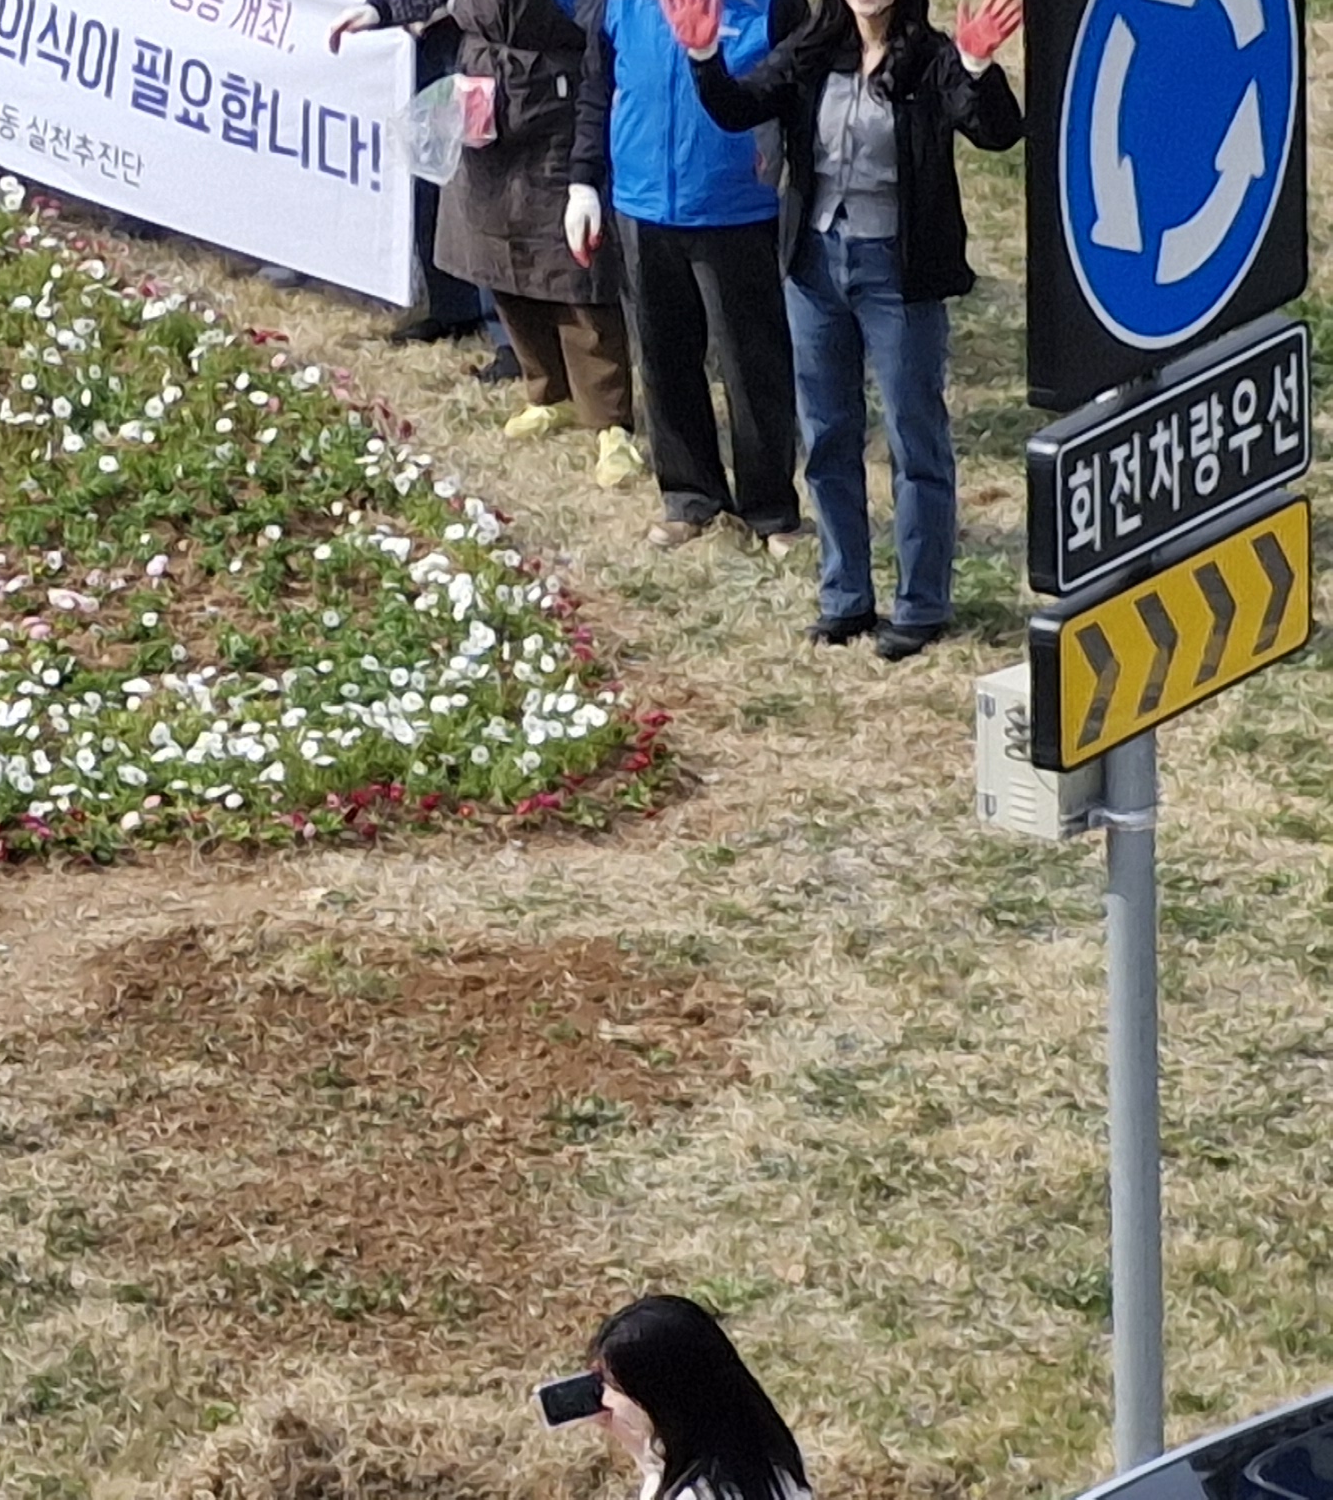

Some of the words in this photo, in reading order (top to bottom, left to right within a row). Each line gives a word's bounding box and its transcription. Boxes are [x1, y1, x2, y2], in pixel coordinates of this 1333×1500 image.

[26, 115, 145, 189] 실천추진단
[131, 37, 382, 193] 필요합니다!
[1067, 351, 1300, 552] 회전차량우선
